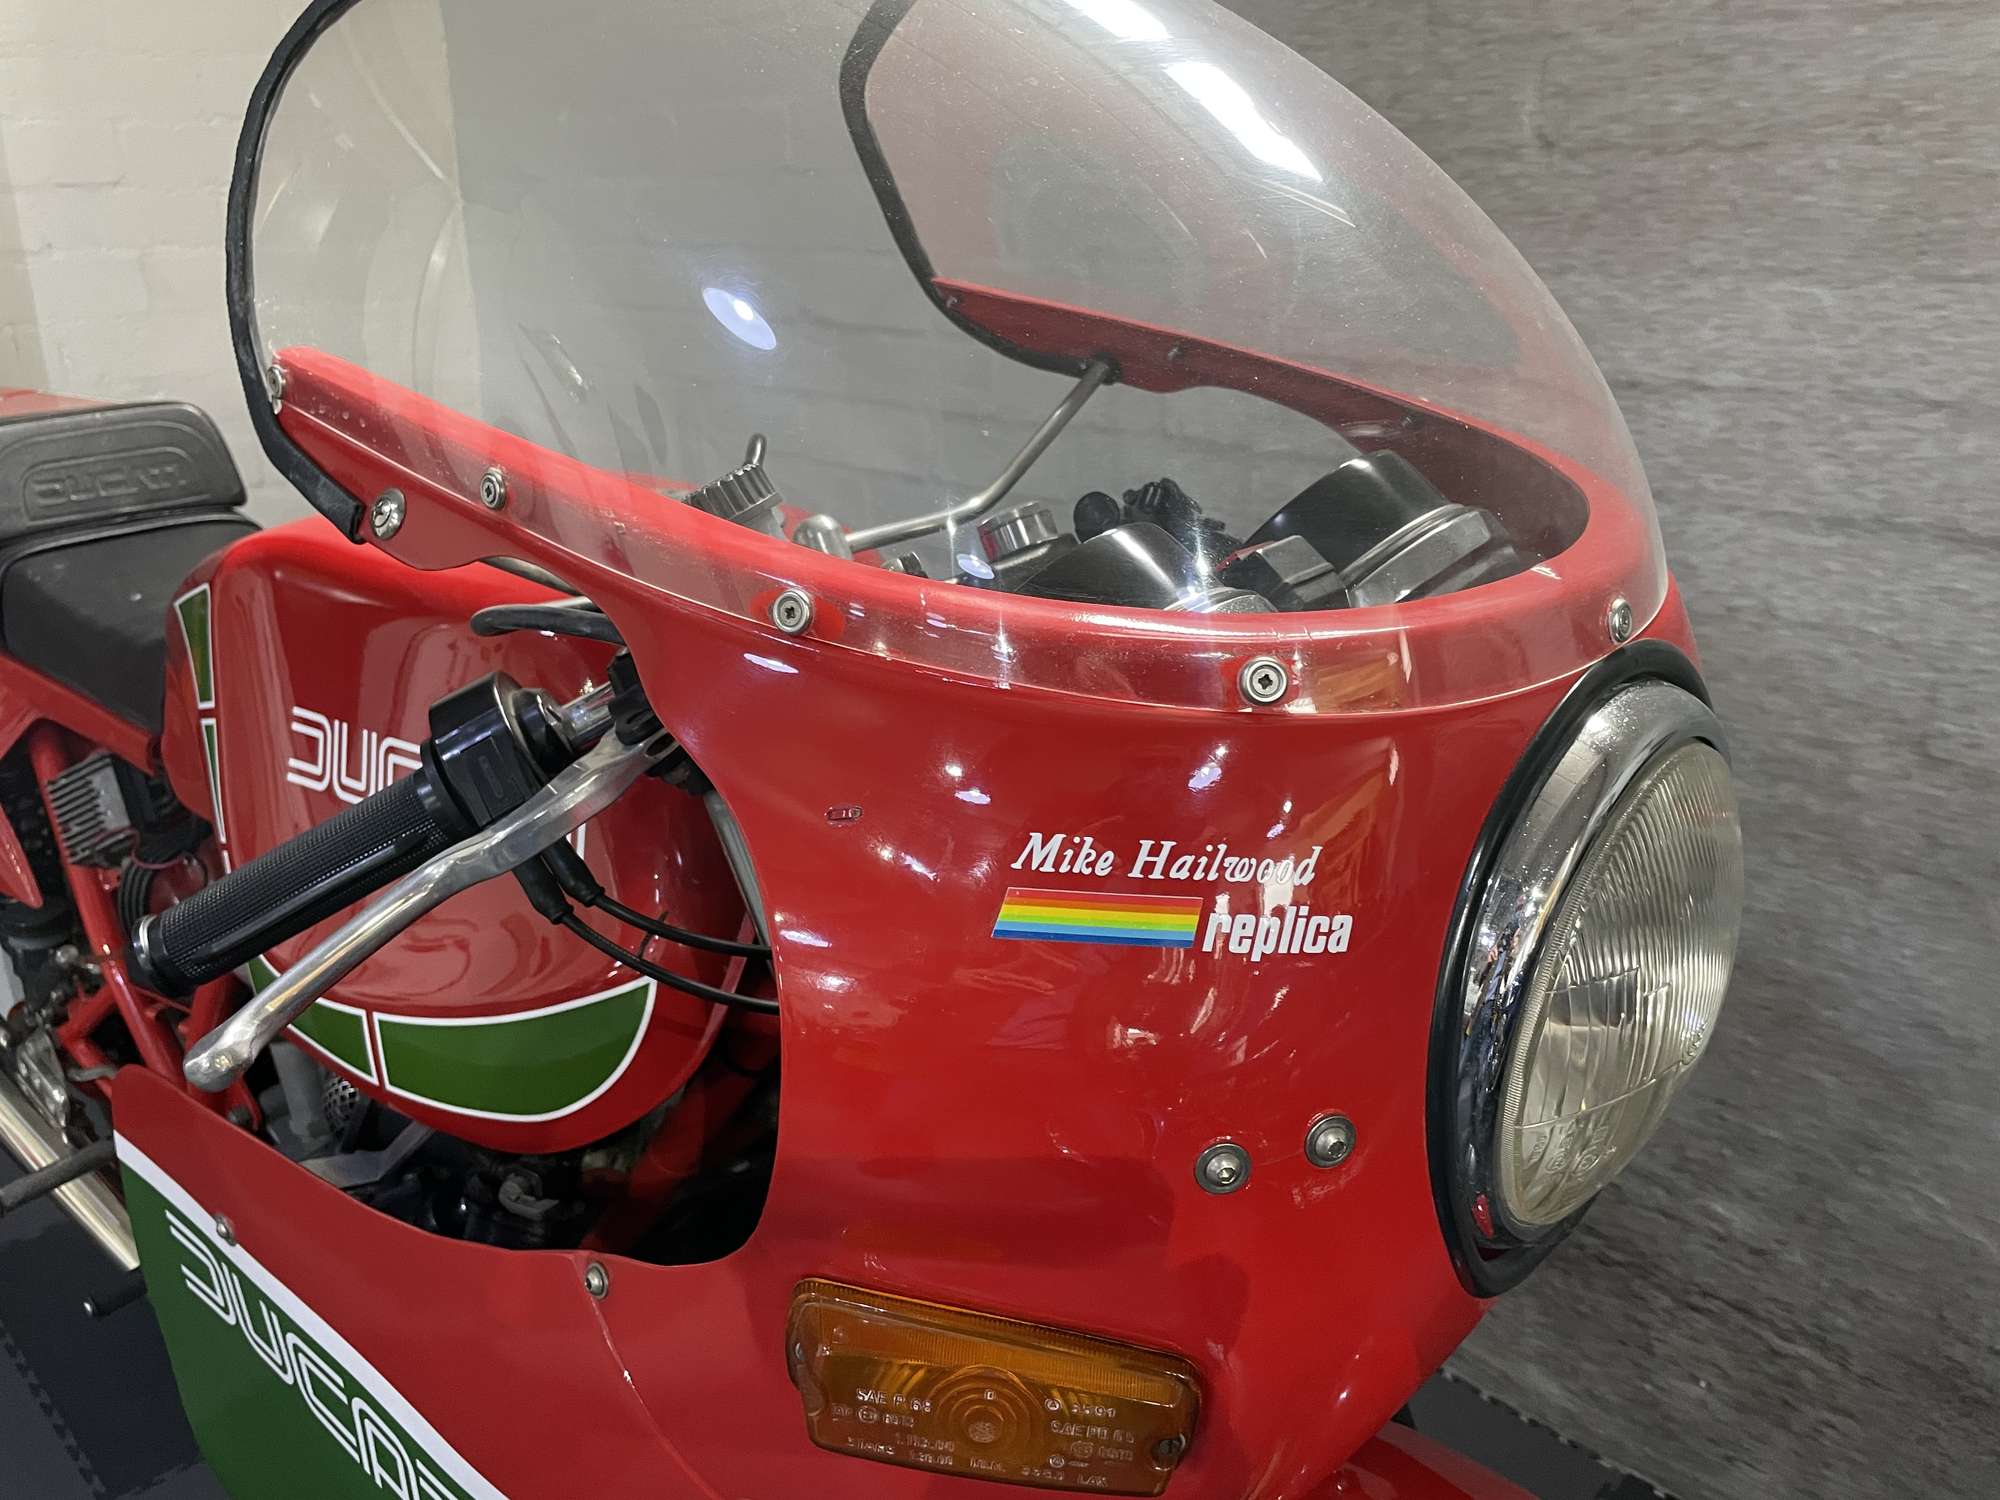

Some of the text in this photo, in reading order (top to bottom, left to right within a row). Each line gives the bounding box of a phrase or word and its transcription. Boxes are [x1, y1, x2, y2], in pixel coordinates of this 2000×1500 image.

[1011, 832, 1323, 886] Mike Hailwood
[1201, 905, 1353, 962] replica
